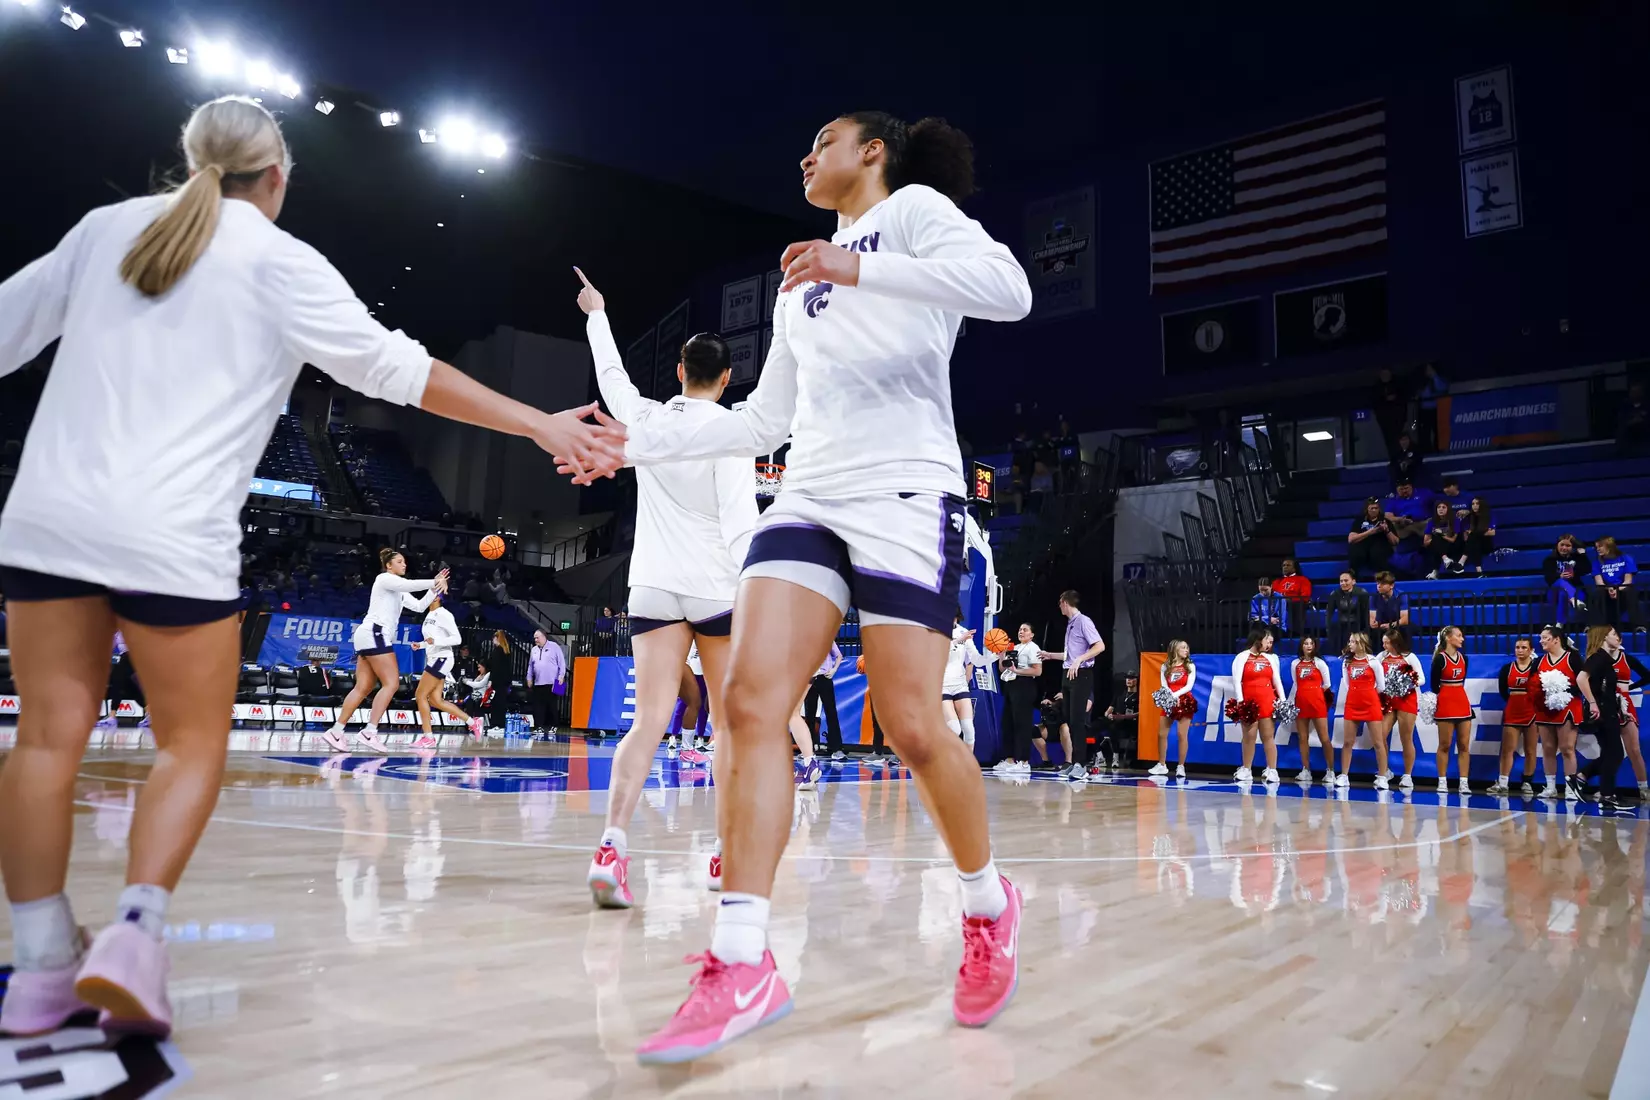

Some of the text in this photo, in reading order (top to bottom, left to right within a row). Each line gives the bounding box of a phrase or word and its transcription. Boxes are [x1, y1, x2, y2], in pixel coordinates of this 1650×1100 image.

[1479, 109, 1493, 124] 12
[1470, 159, 1509, 174] HANSEN
[1034, 240, 1086, 260] CHAMPIONSHIP
[729, 294, 753, 309] 1979
[731, 350, 751, 363] 020
[1454, 402, 1557, 424] #MARCHMADNESS
[976, 482, 989, 498] 30
[283, 617, 344, 643] FOUR
[560, 622, 571, 630] EXIT
[307, 645, 328, 653] MARCH
[309, 651, 338, 660] MADNESS
[309, 665, 318, 674] 15
